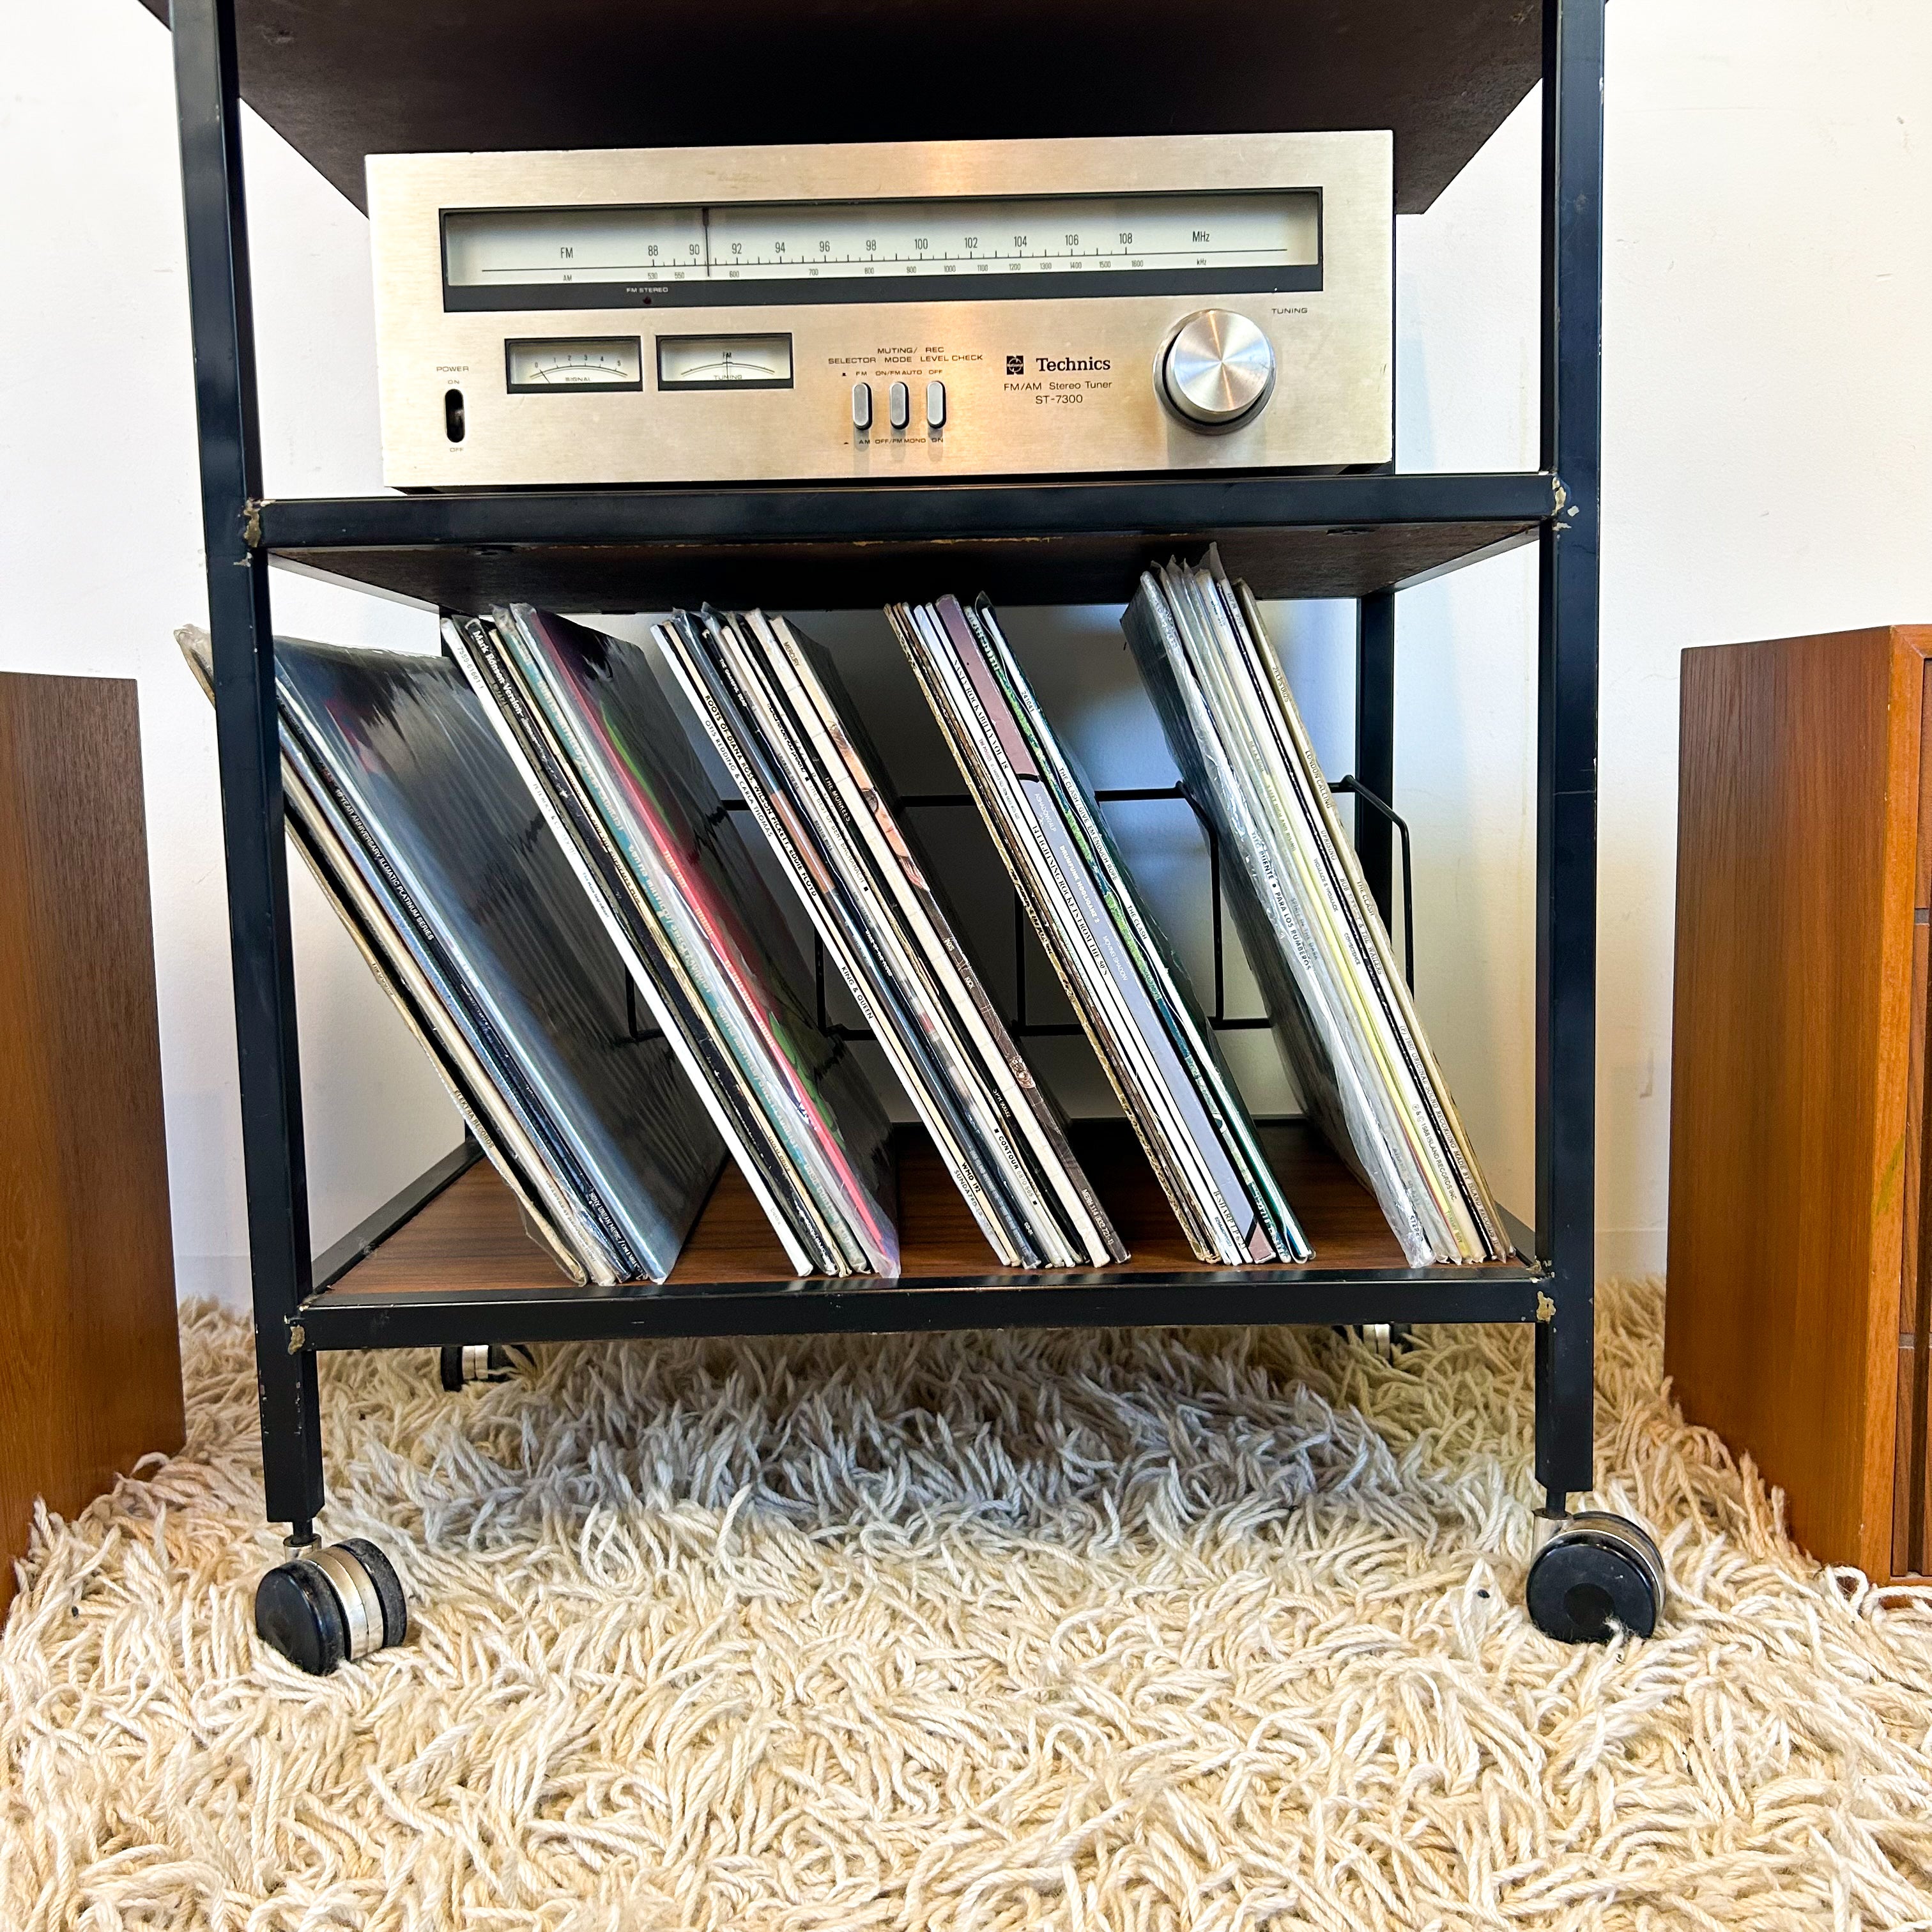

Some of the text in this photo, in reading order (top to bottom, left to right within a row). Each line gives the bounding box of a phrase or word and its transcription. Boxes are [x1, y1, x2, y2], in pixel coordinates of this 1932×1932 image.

[560, 231, 1210, 258] FM 88 90 92 94 96 98 100 102 104 106 108 MHz
[1004, 382, 1042, 391] FM/AM
[1049, 382, 1081, 390] Stereo
[1036, 356, 1111, 372] Technics
[1035, 394, 1083, 404] ST-7300
[471, 629, 491, 654] Mark
[484, 652, 508, 684] Ronson
[500, 682, 525, 715] Version
[718, 657, 727, 669] THE
[781, 641, 802, 668] MERCURY
[952, 659, 968, 686] NASTY
[965, 687, 993, 739] ROCKABILLY
[1000, 760, 1009, 769] 18
[1020, 690, 1035, 712] 241041
[704, 719, 717, 737] OTIS
[714, 738, 737, 771] REDDING
[739, 780, 755, 804] CARLA
[752, 805, 774, 838] THOMAS
[704, 694, 818, 896] ROOTS OF DIANA ROSS, WILSON PICKETT, EDDIE FLOYD
[824, 776, 834, 790] THE
[829, 789, 853, 822] MONKEES
[1304, 749, 1332, 809] LONDON CALLING
[1058, 767, 1068, 781] THE
[1065, 781, 1079, 802] CLASH
[1077, 806, 1089, 824] GIVE
[1092, 835, 1109, 863] ENOUGH
[1105, 863, 1118, 881] ROPE
[1279, 818, 1289, 831] AND
[339, 796, 435, 941] YEAR ANNIVERSARY ILLMATIC PLATINUM SERIES
[1032, 825, 1039, 833] 14
[1036, 834, 1062, 880] LIGHTNING
[1058, 880, 1080, 918] ROCKETS
[1077, 918, 1092, 942] FROM
[1089, 944, 1100, 959] THE
[1058, 844, 1080, 882] DRUMFUNK
[1075, 880, 1098, 918] HOOLIGANZ
[1312, 857, 1327, 883] WOMACK
[1324, 887, 1338, 912] WOMACK
[1126, 905, 1147, 940] THE CLASH
[1257, 850, 1313, 970] PUENTE PARA LOS RUMBEROS
[1320, 829, 1337, 861] UPRISING
[1339, 877, 1349, 891] BOB
[1361, 930, 1370, 944] THE
[1367, 946, 1383, 975] WAILERS
[1356, 880, 1375, 916] THE CLASH
[1101, 935, 1128, 981] MOVING SHADOW
[841, 965, 855, 985] KING
[856, 993, 874, 1019] QUEEN
[452, 1089, 495, 1149] ELEKTRA RECORDS
[1404, 1036, 1415, 1051] 1980
[1410, 1052, 1429, 1084] ORIGINAL
[1425, 1085, 1439, 1108] SOUND
[1435, 1109, 1456, 1149] RECORDING
[1452, 1149, 1465, 1170] MADE
[1462, 1170, 1470, 1181] BY
[1468, 1182, 1482, 1207] ISLAND
[1478, 1207, 1496, 1238] RECORDS
[960, 1162, 981, 1193] WMD 192
[997, 1135, 1020, 1169] CONTOUR
[1425, 1135, 1440, 1160] ISLAND
[1435, 1158, 1453, 1190] RECORDS
[1213, 1190, 1234, 1224] B-SHARP
[1230, 1224, 1239, 1236] LP
